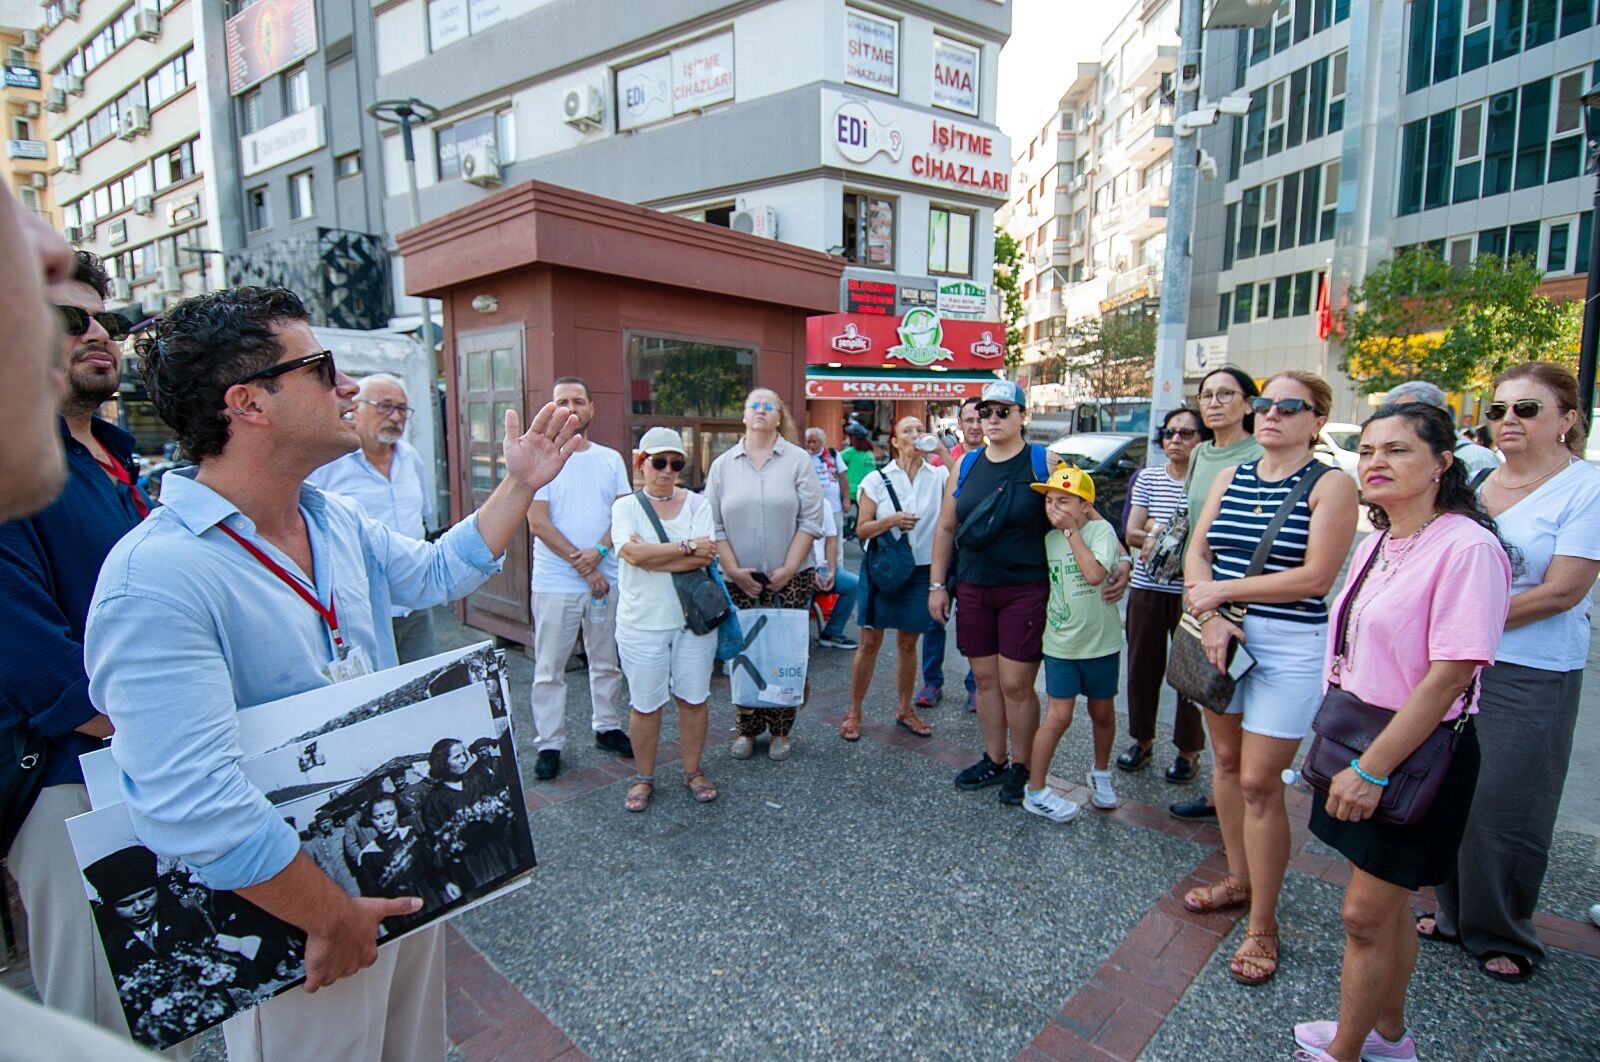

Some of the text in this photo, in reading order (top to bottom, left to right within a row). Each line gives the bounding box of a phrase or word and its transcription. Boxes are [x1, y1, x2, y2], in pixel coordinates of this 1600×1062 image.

[934, 63, 973, 93] AMA
[931, 119, 993, 157] İŞİTME
[911, 152, 1009, 192] CİHAZLARI
[842, 382, 967, 395] KRAL PİLİÇ
